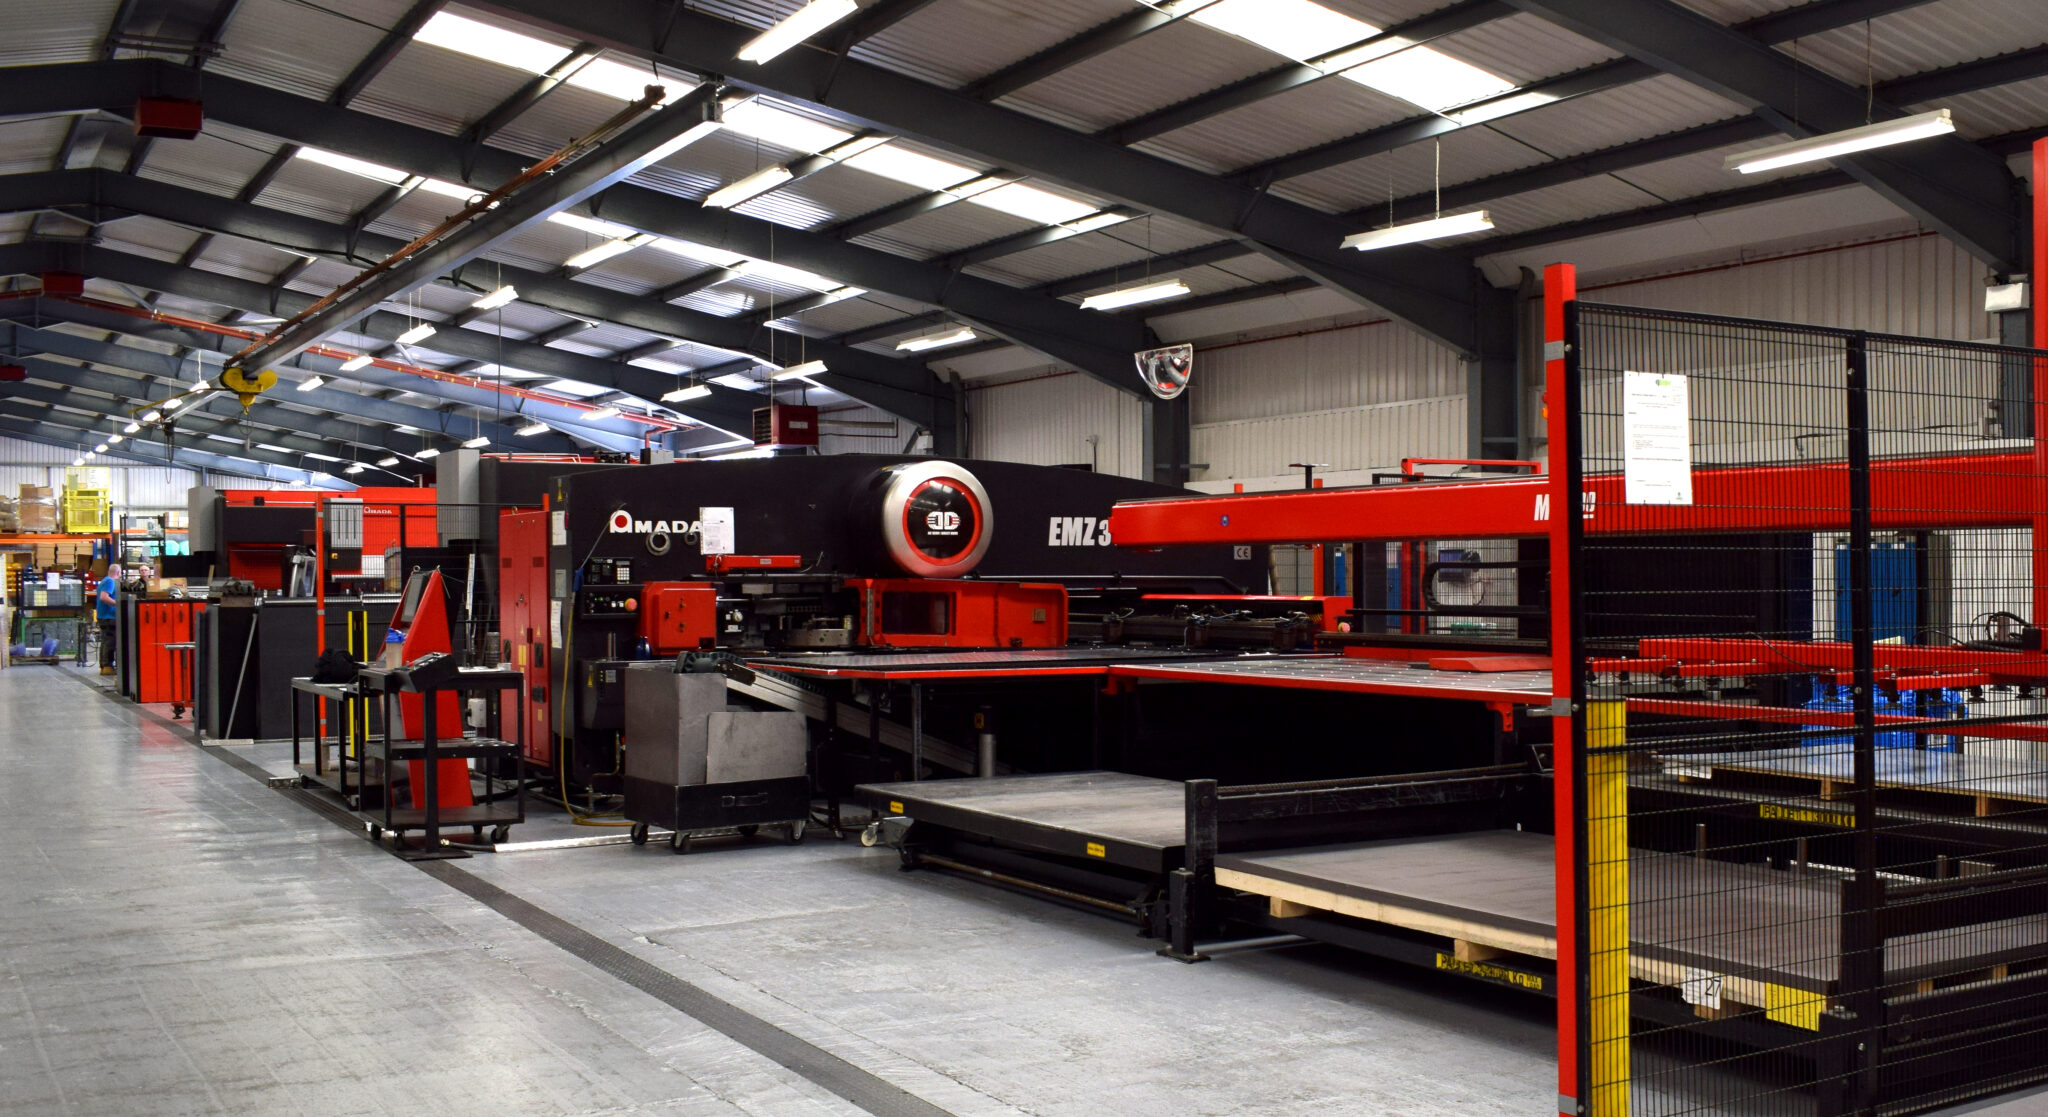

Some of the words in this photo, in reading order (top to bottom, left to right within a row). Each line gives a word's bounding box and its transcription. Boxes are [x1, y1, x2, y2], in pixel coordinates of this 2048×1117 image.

[609, 509, 703, 534] AMADA
[1048, 517, 1097, 546] EMZ
[1236, 547, 1249, 559] CE
[1705, 977, 1721, 998] 27
